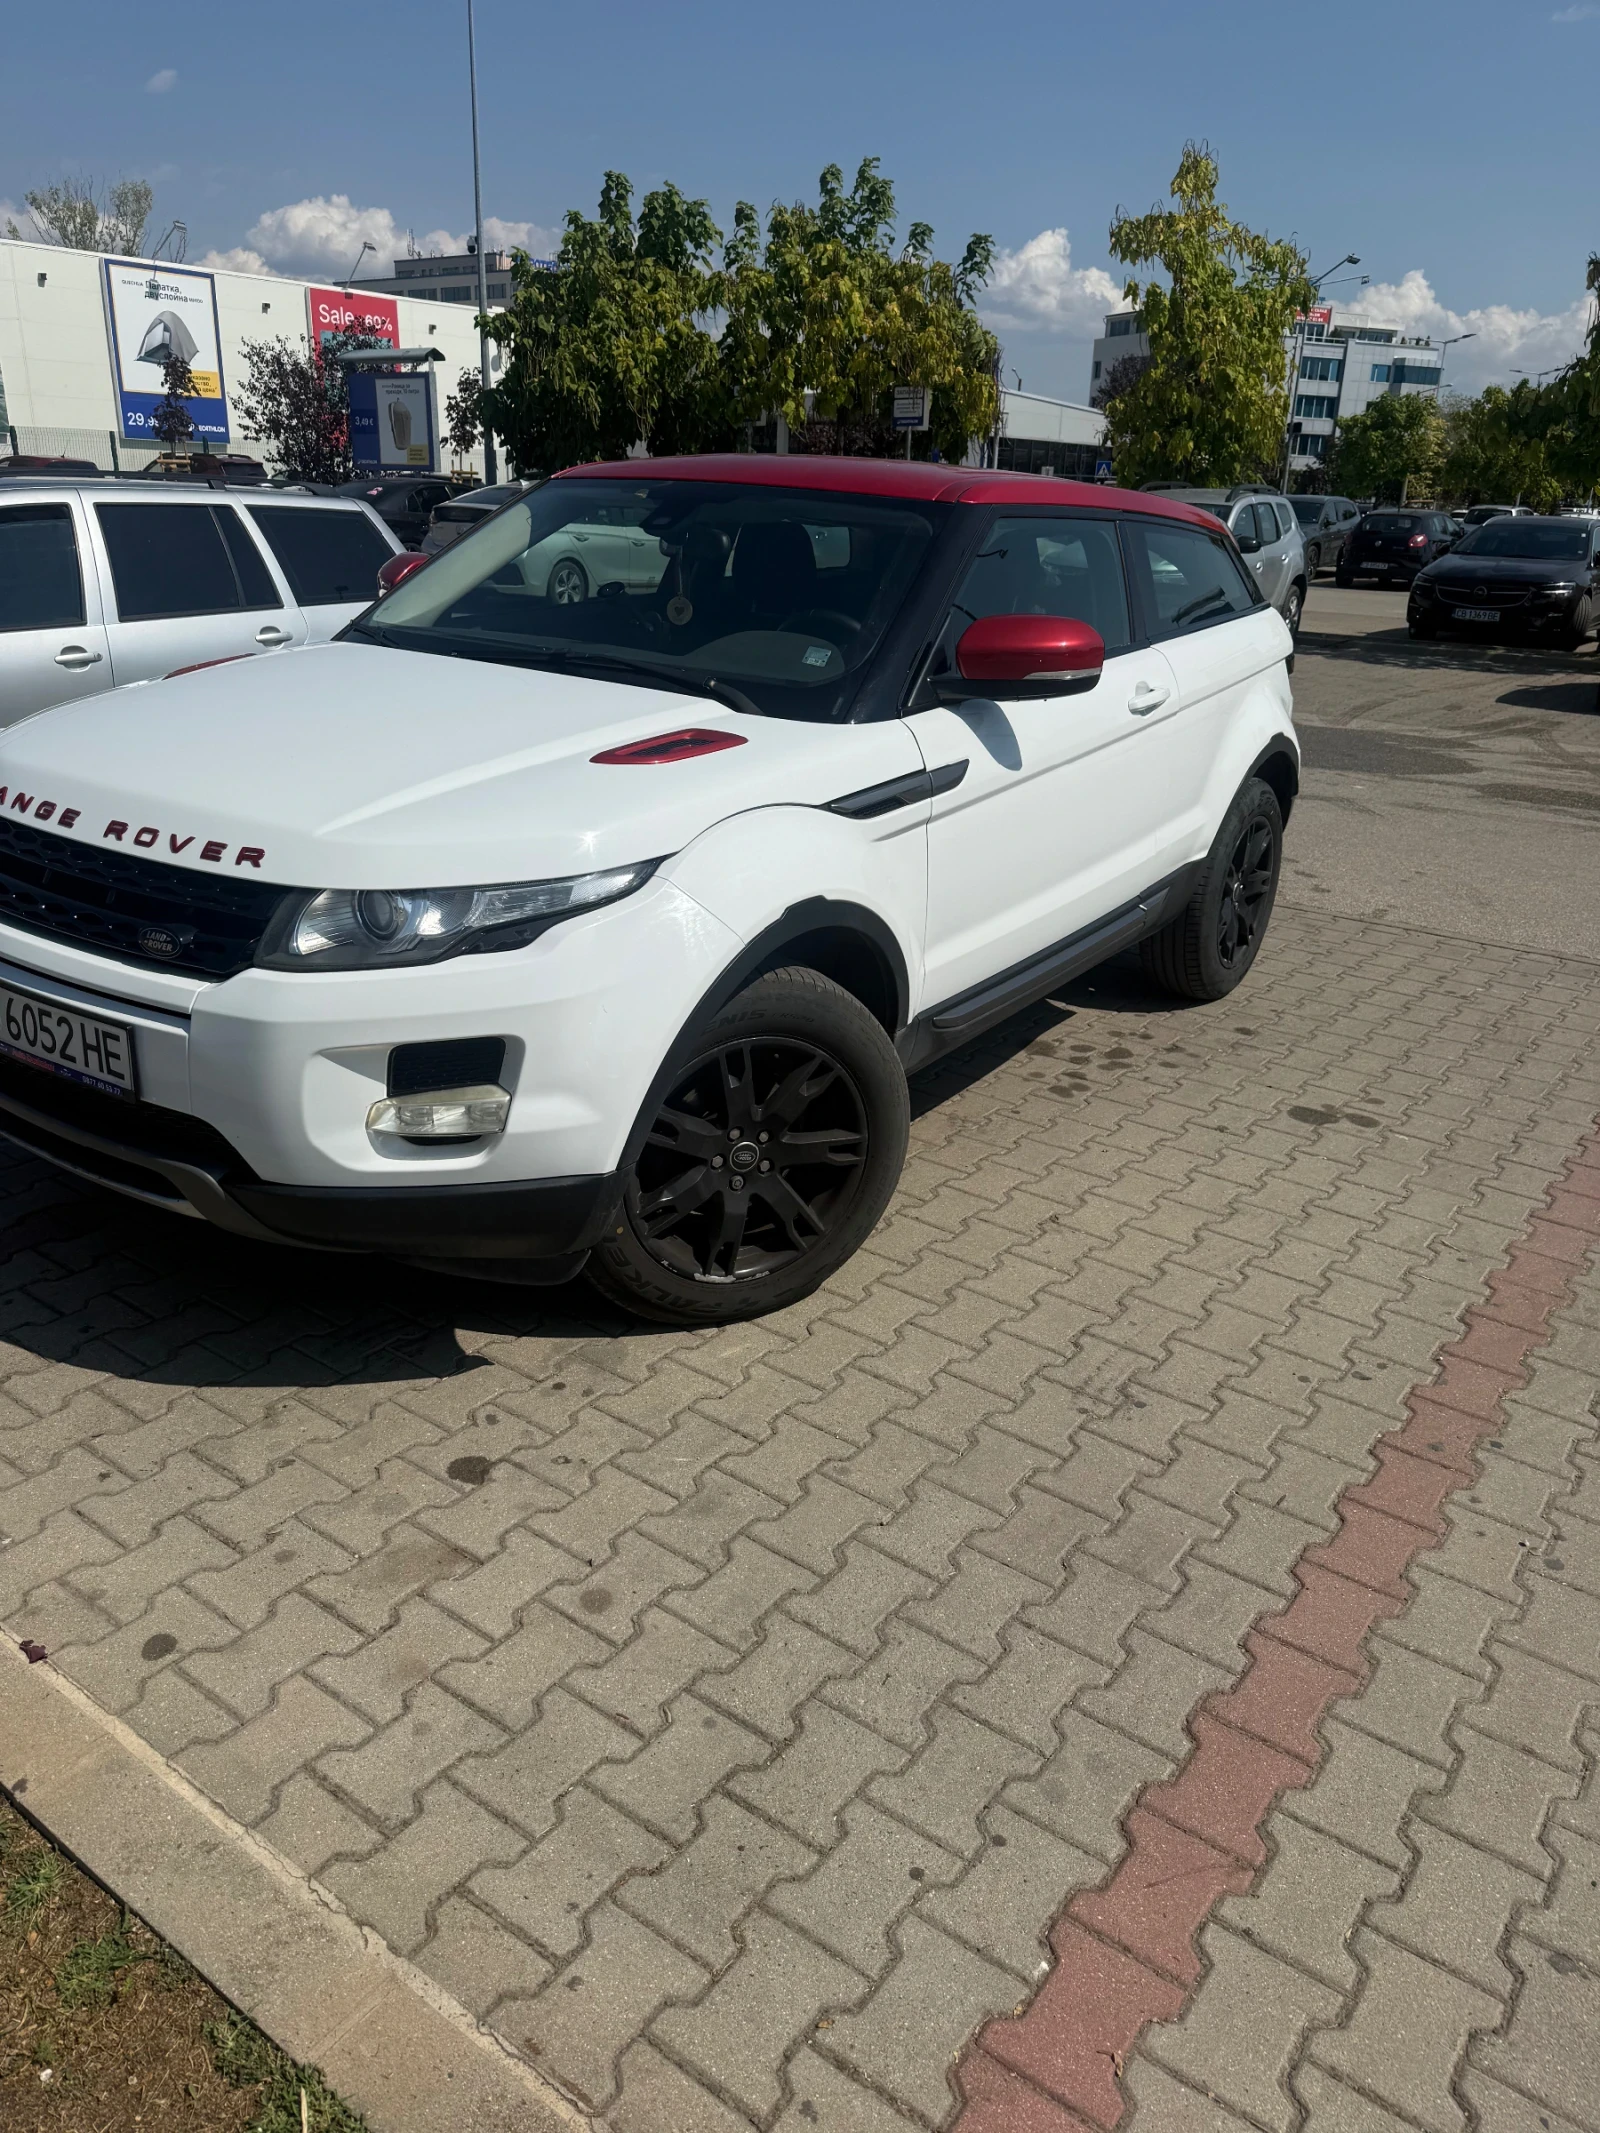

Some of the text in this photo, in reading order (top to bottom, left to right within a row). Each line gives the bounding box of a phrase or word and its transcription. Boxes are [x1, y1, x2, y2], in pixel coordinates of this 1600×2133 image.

[145, 280, 182, 294] Палатка,
[144, 290, 188, 303] двуслойна
[319, 304, 355, 325] Sale
[354, 416, 369, 426] 3,49
[1456, 608, 1499, 622] CB 1369 BE
[102, 819, 266, 868] ROVER
[146, 930, 167, 942] LAND
[147, 939, 173, 952] ROVER
[5, 997, 126, 1081] 6052 HE
